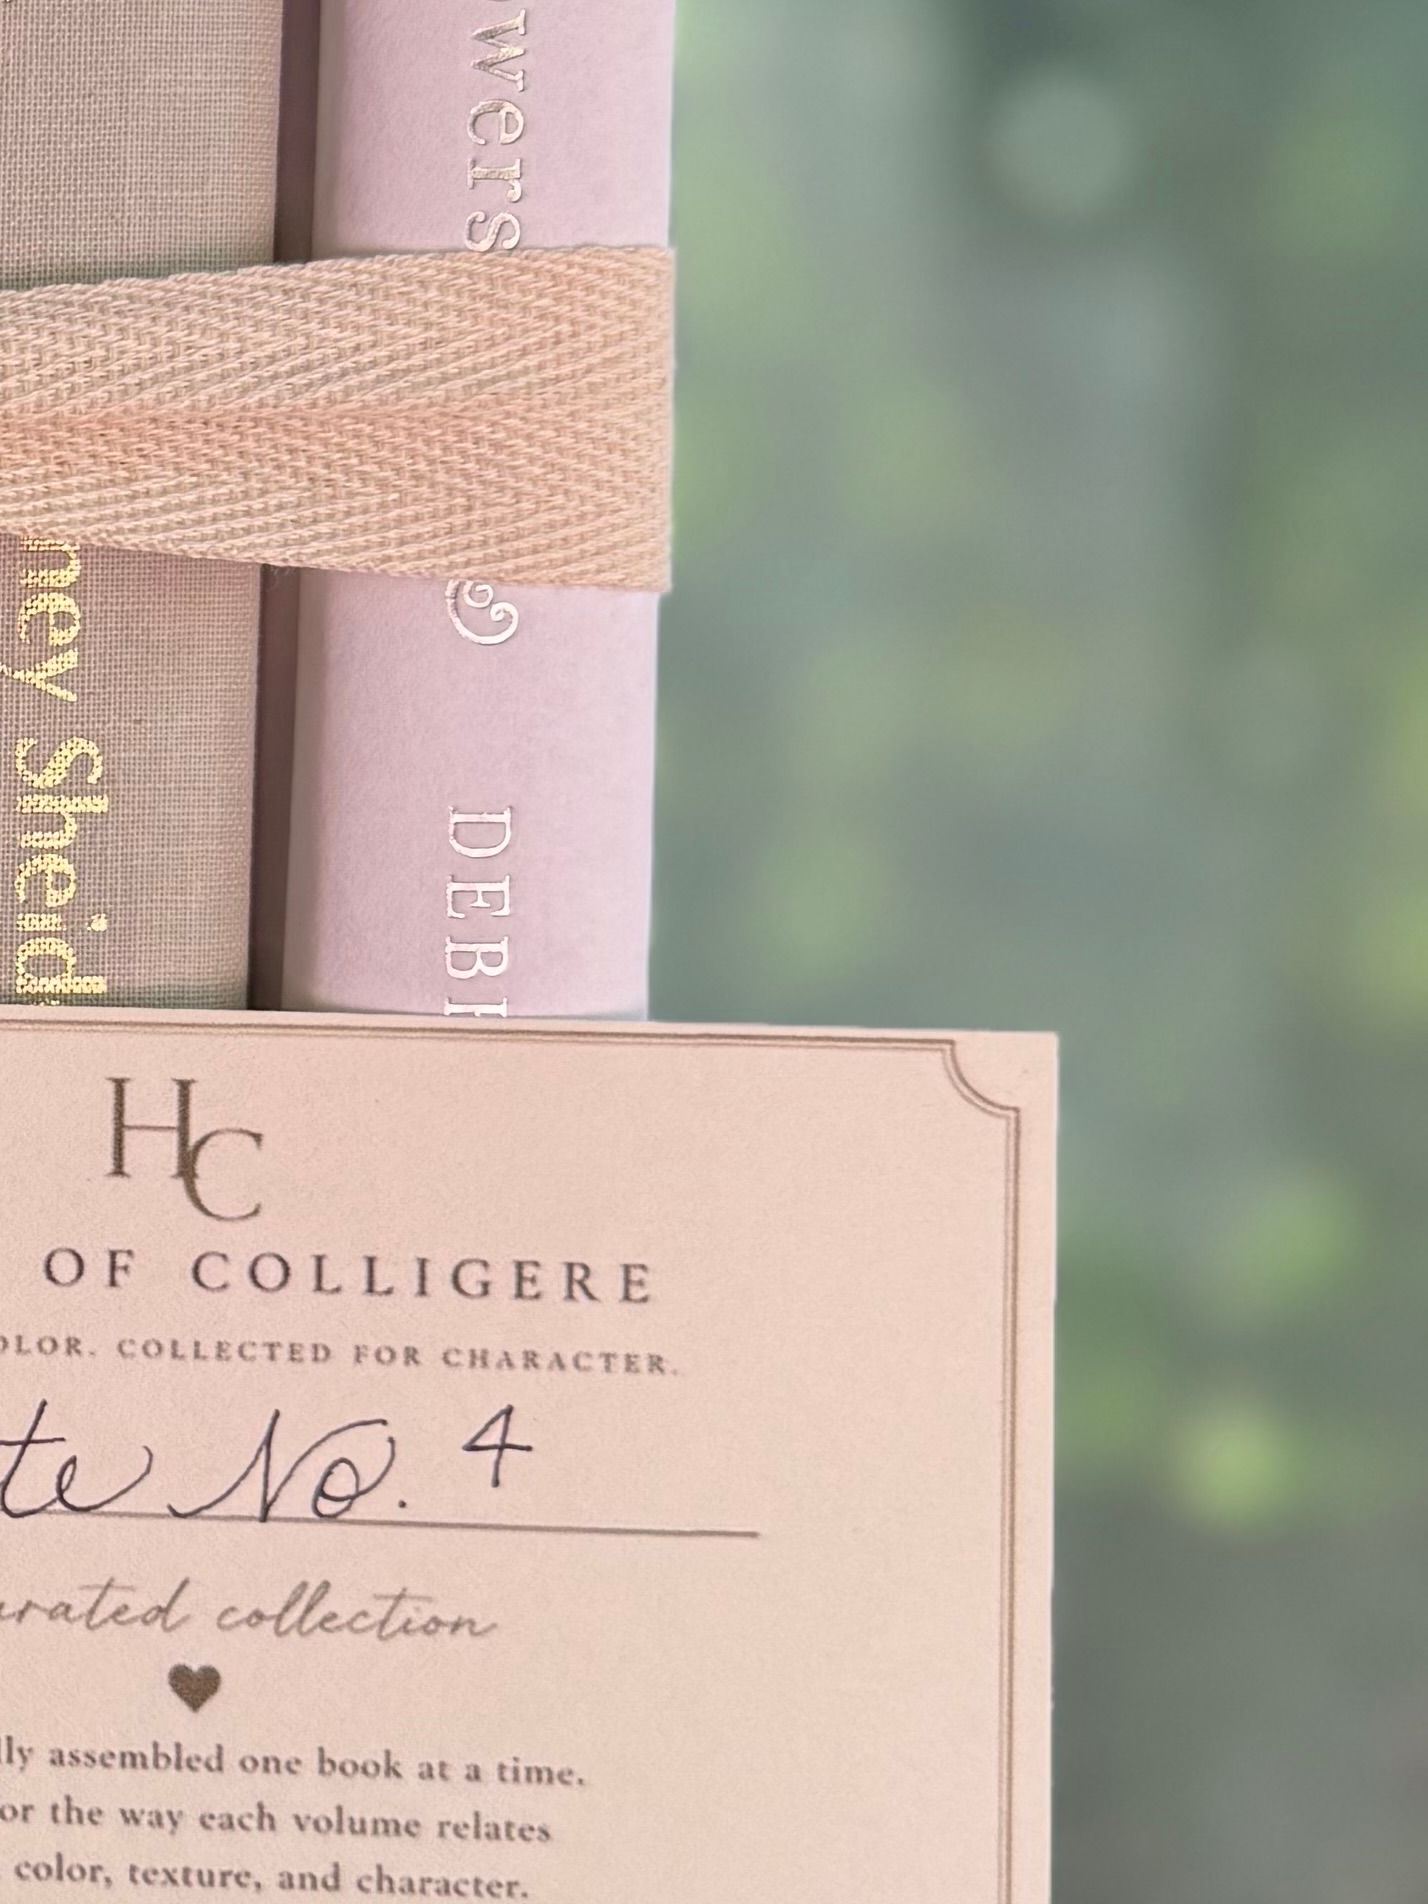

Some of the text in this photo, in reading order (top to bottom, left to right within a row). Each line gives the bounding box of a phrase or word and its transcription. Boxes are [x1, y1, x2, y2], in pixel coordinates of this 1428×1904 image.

[42, 1247, 135, 1289] OF
[190, 1250, 651, 1305] COLLIGERE
[116, 1338, 332, 1364] COLLECTED
[353, 1344, 422, 1368] FOR
[441, 1347, 677, 1376] CHARACTER.
[168, 1409, 409, 1521] No.
[462, 1405, 532, 1487] 4
[215, 1579, 498, 1642] collection
[48, 1740, 225, 1774] assembled
[238, 1755, 303, 1776] one
[317, 1745, 404, 1780] book
[417, 1760, 451, 1783] at
[464, 1763, 483, 1783] a
[496, 1756, 586, 1787] time.
[50, 1794, 105, 1827] the
[118, 1807, 184, 1836] way
[198, 1801, 277, 1833] each
[292, 1804, 422, 1839] volume
[437, 1810, 553, 1844] relates
[13, 1851, 113, 1890] color,
[128, 1863, 263, 1895] texture,
[277, 1861, 342, 1893] and
[355, 1863, 529, 1900] character.
